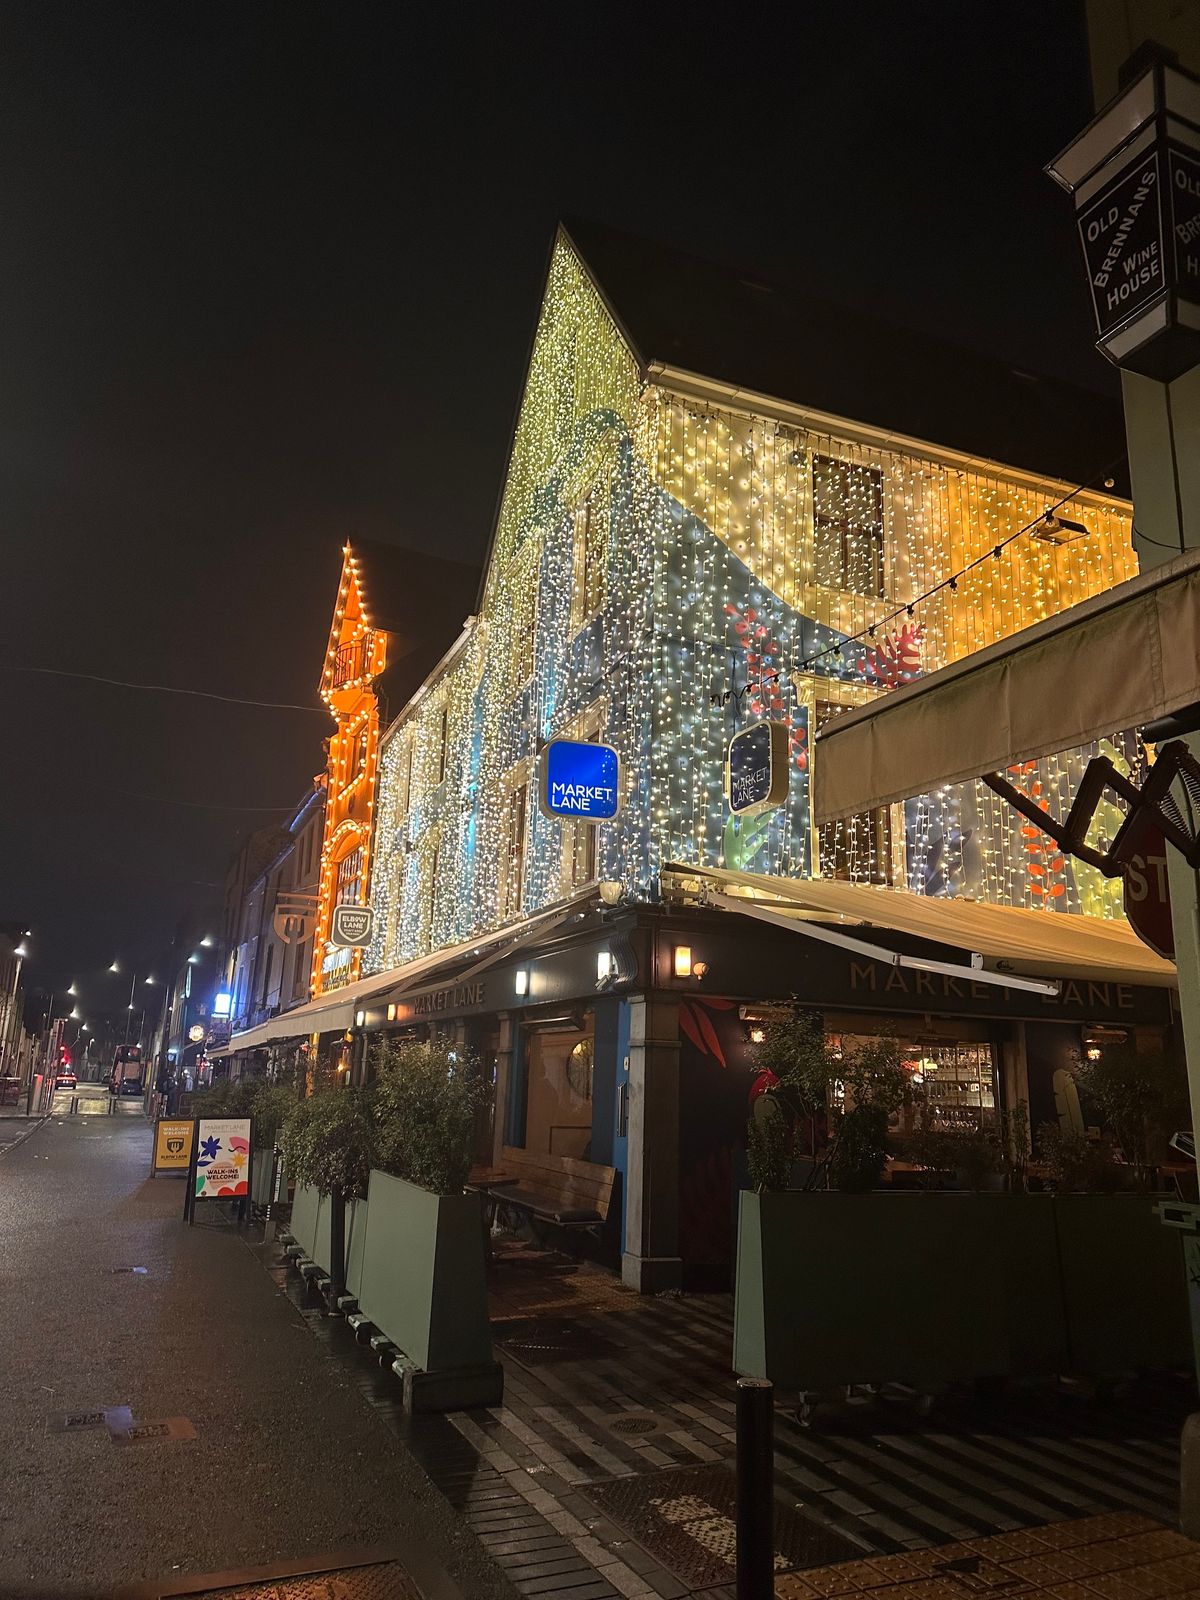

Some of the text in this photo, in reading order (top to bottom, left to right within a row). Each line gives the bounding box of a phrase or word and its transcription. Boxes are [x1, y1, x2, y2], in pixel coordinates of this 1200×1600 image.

[1087, 206, 1119, 242] OLD
[1094, 171, 1156, 288] BRENNANS
[1122, 240, 1159, 275] WINE
[1106, 258, 1160, 311] HOUSE
[552, 782, 613, 801] MARKET
[732, 766, 768, 792] MARKET
[551, 794, 591, 811] LANE
[732, 786, 755, 807] LANE
[1127, 854, 1167, 903] ST
[343, 921, 363, 929] LANE
[414, 982, 485, 1015] MARKET LANE
